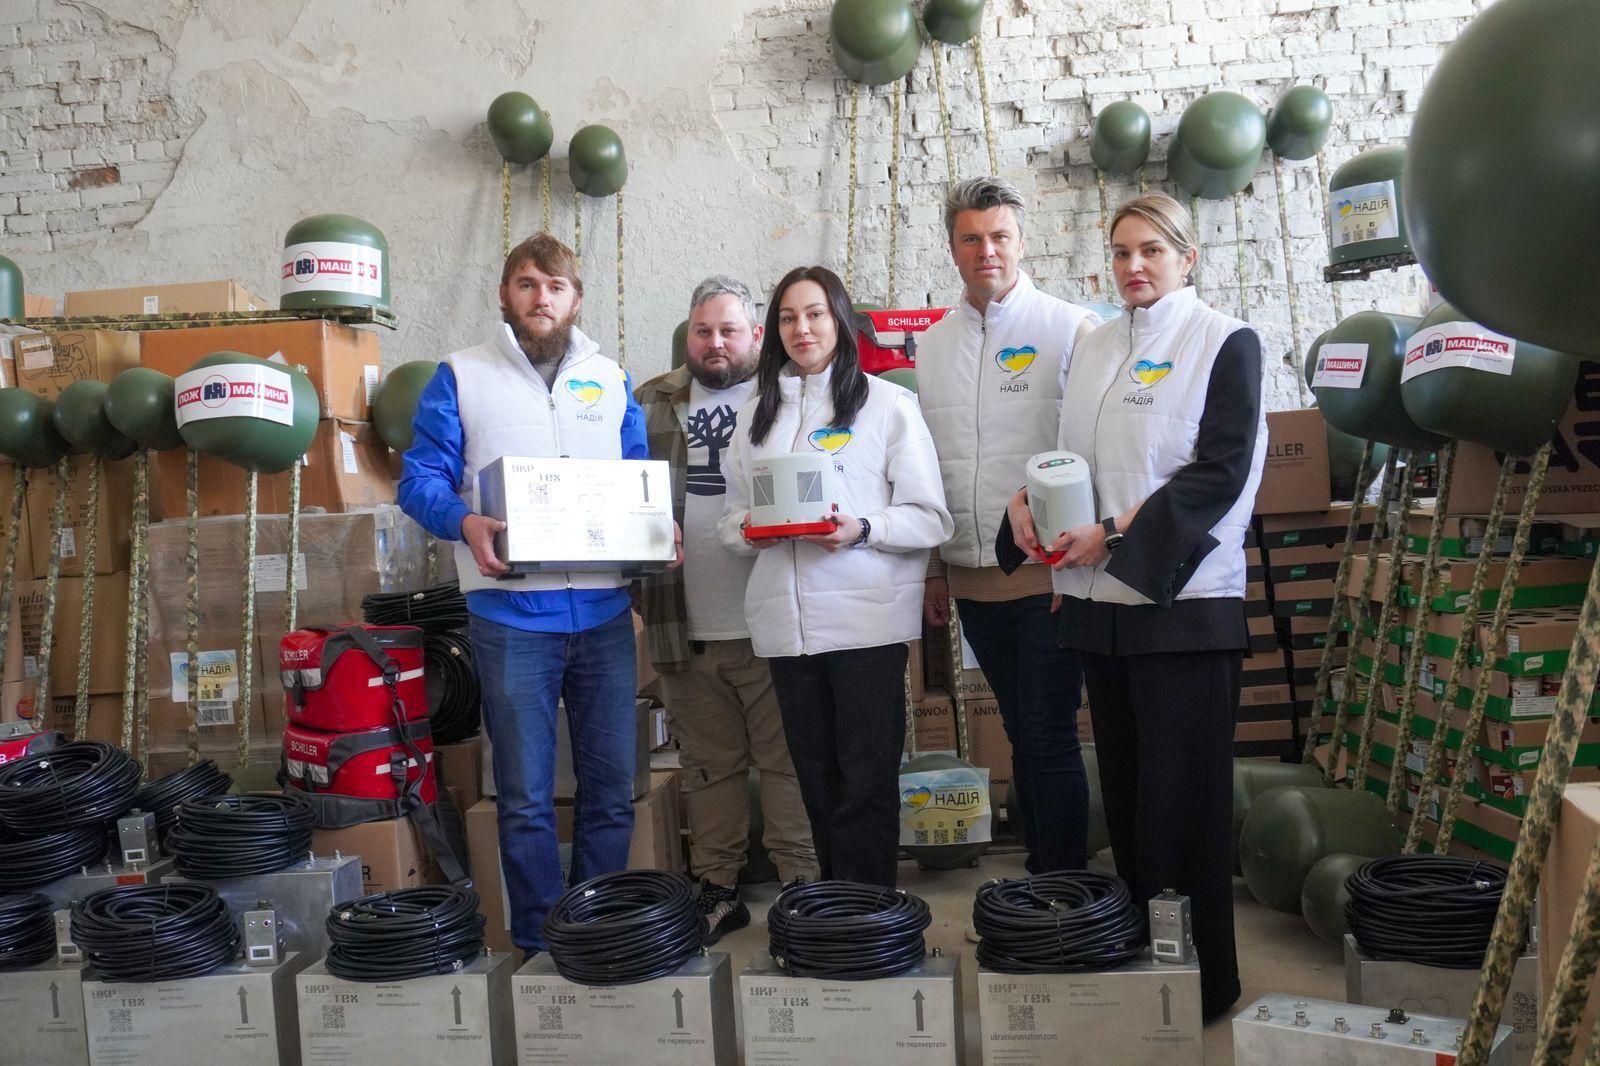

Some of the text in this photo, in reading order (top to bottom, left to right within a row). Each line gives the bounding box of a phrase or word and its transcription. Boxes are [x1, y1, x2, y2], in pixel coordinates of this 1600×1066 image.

[1354, 199, 1389, 213] НАДІЯ
[888, 317, 931, 326] SCHILLER
[1327, 361, 1359, 370] МАШИНА
[1000, 384, 1029, 393] НАДІЯ
[179, 390, 199, 403] ПОЖ
[1123, 395, 1154, 406] НАДІЯ
[576, 413, 603, 422] НАДІЯ
[284, 649, 308, 661] SCHILLER
[201, 665, 231, 675] НАДІЯ
[291, 741, 317, 756] SCHILLER
[934, 791, 980, 806] НАДІЯ
